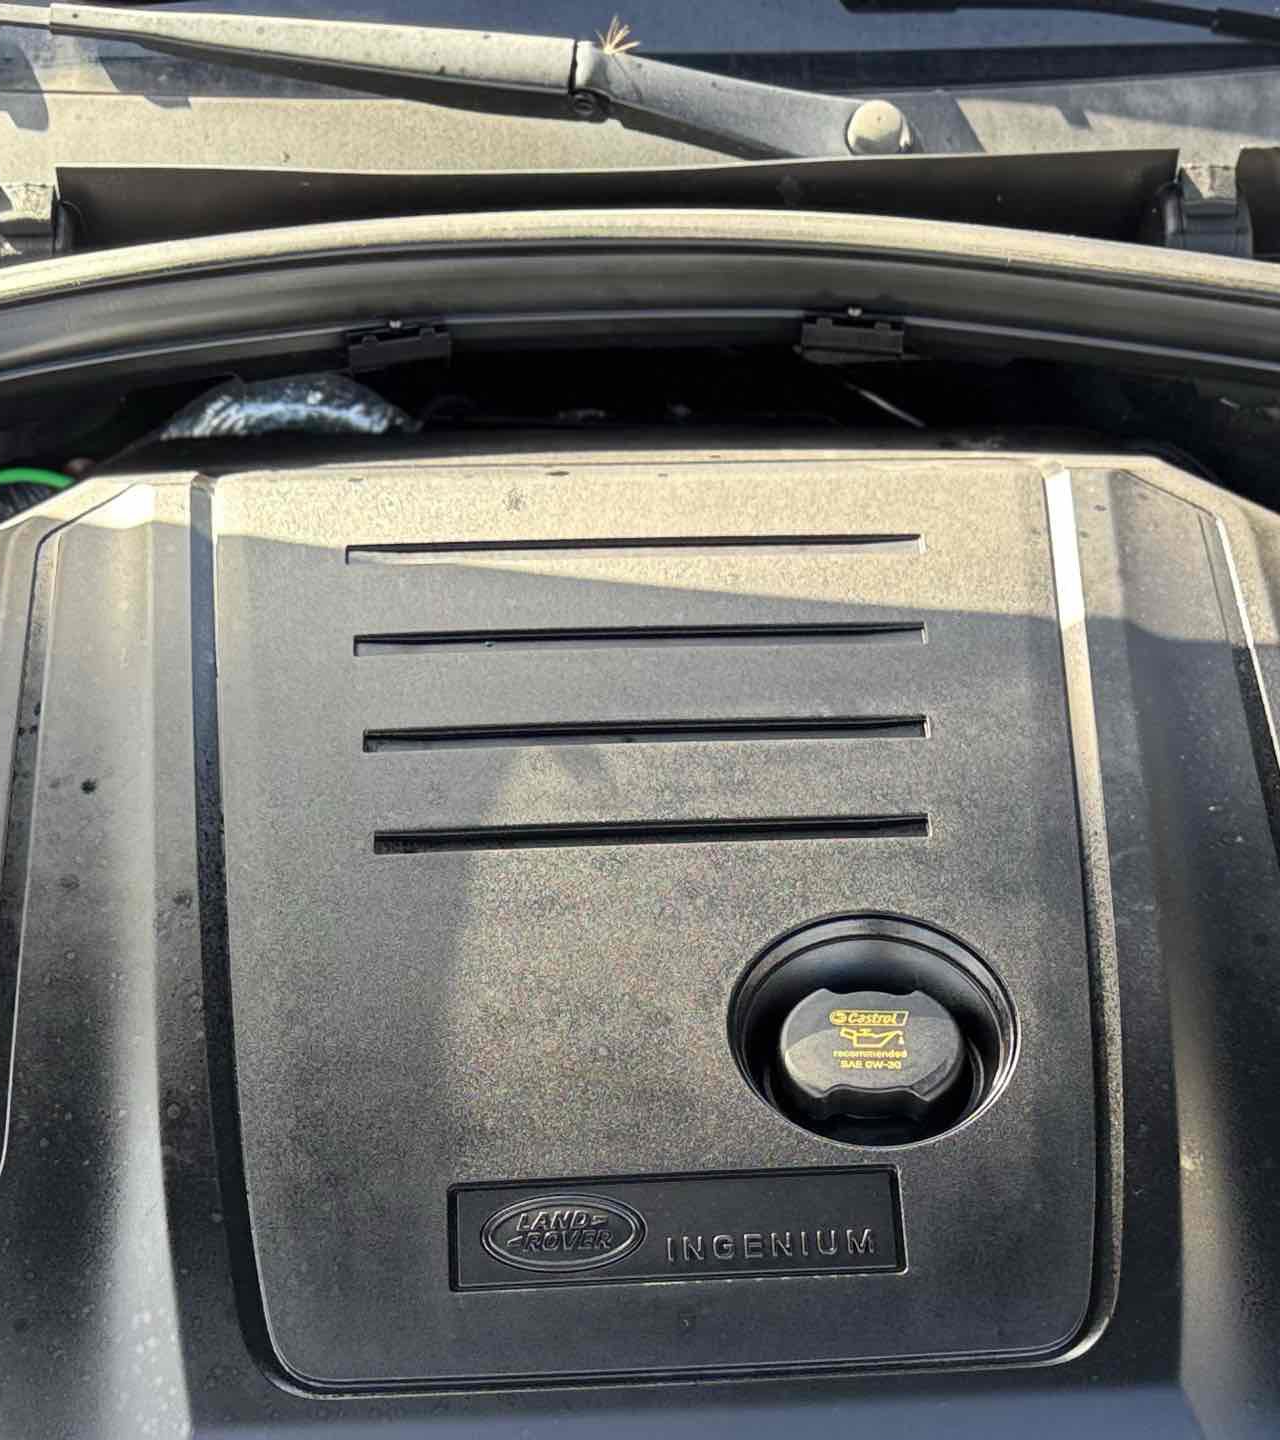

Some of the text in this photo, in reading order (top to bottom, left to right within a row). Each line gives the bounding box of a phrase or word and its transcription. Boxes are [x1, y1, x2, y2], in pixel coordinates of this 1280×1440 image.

[847, 1012, 897, 1024] Castrol
[833, 1048, 907, 1058] recommended
[840, 1059, 902, 1069] SAE 0W-30
[516, 1209, 592, 1232] LAND
[522, 1230, 613, 1253] ROVER
[666, 1227, 876, 1263] INGENIUM
